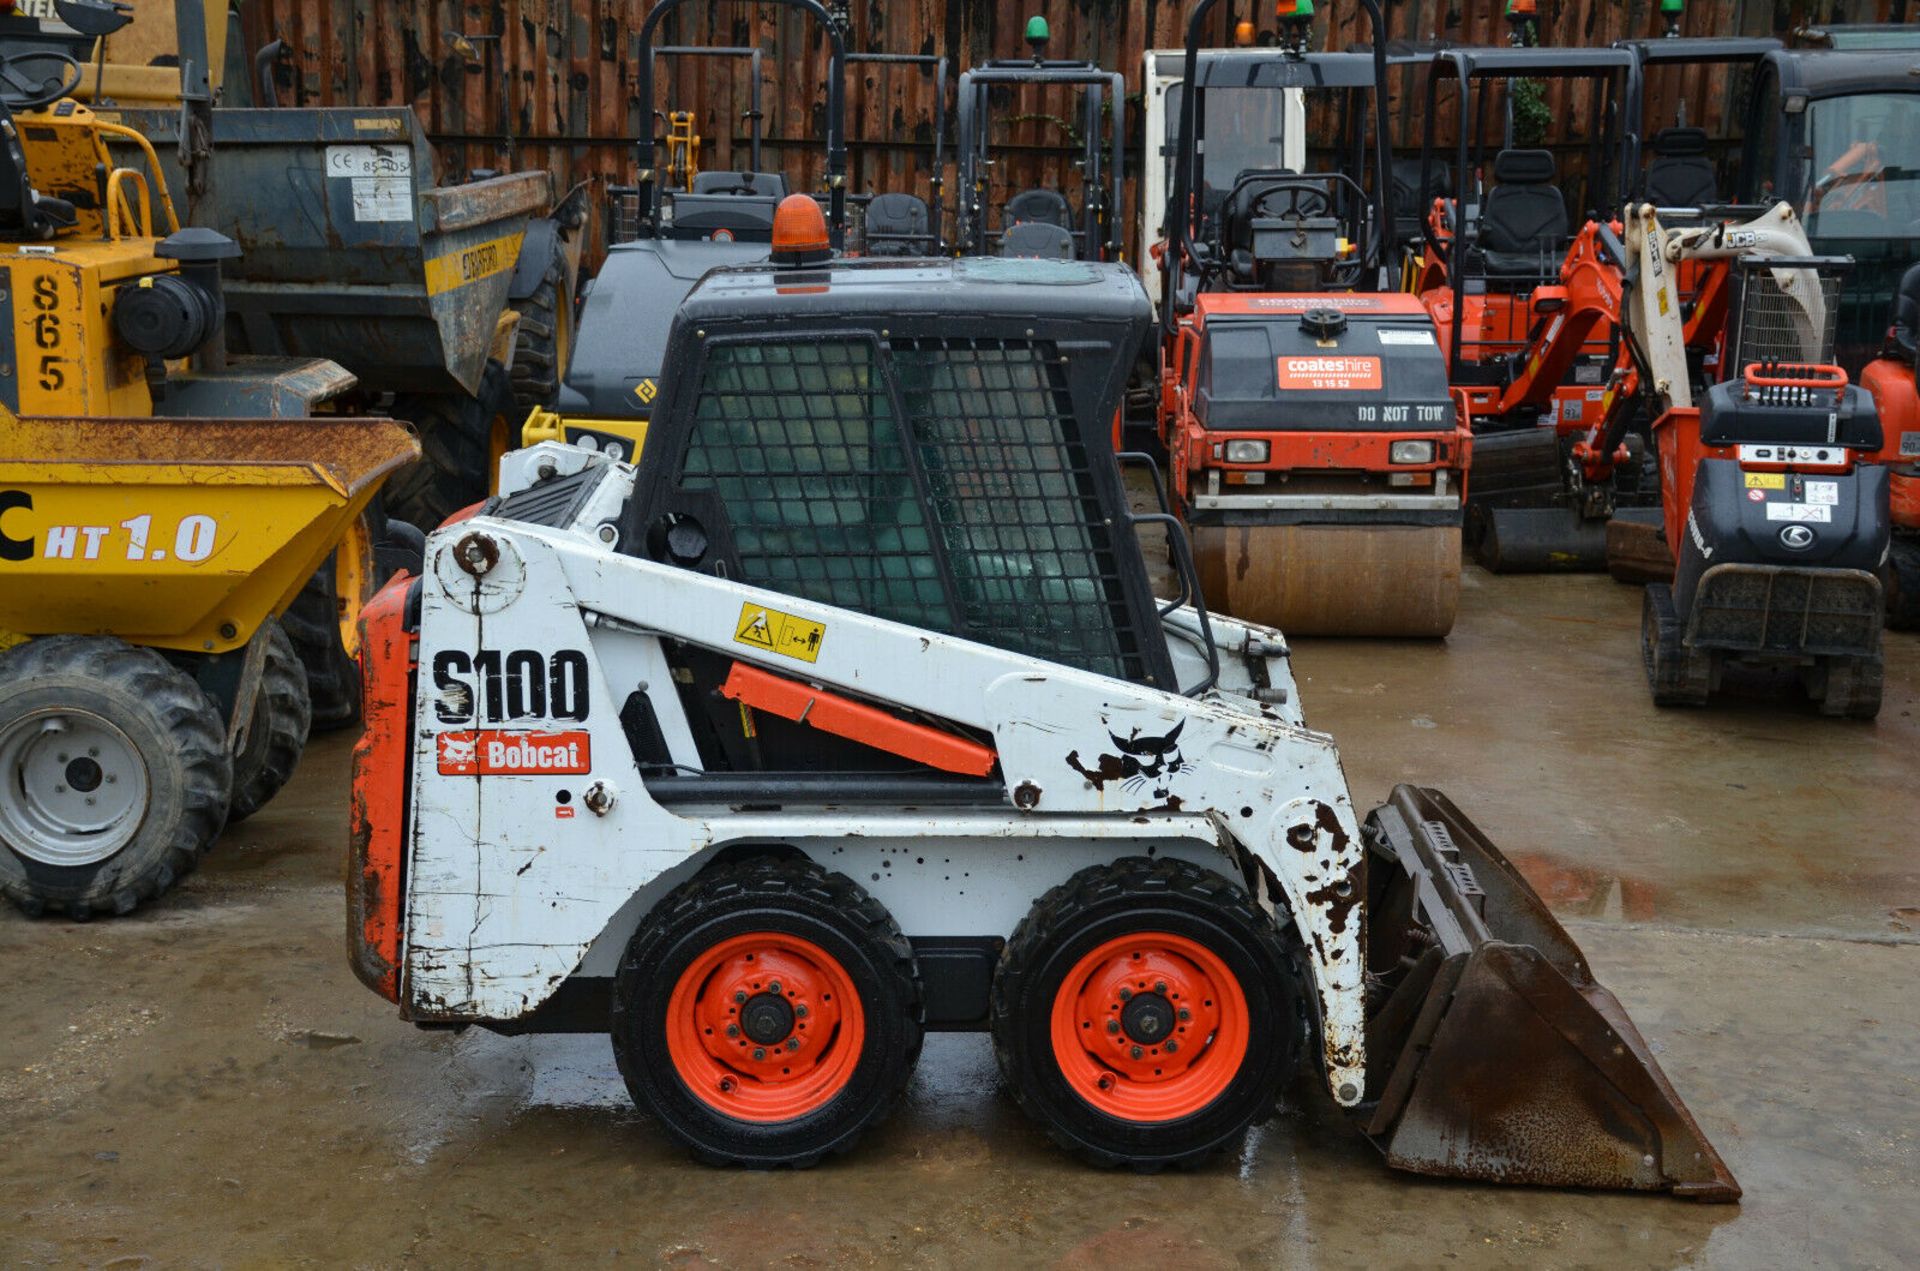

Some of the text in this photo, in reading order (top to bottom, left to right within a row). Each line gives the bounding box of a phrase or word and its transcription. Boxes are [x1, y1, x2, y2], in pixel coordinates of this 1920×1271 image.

[1727, 232, 1757, 248] JCB
[1313, 379, 1351, 388] 13 15 52
[1358, 406, 1444, 422] DO NOT TOW
[43, 525, 110, 560] HT
[120, 513, 217, 562] 1.0
[433, 649, 590, 724] S100
[488, 737, 580, 769] Bobcat
